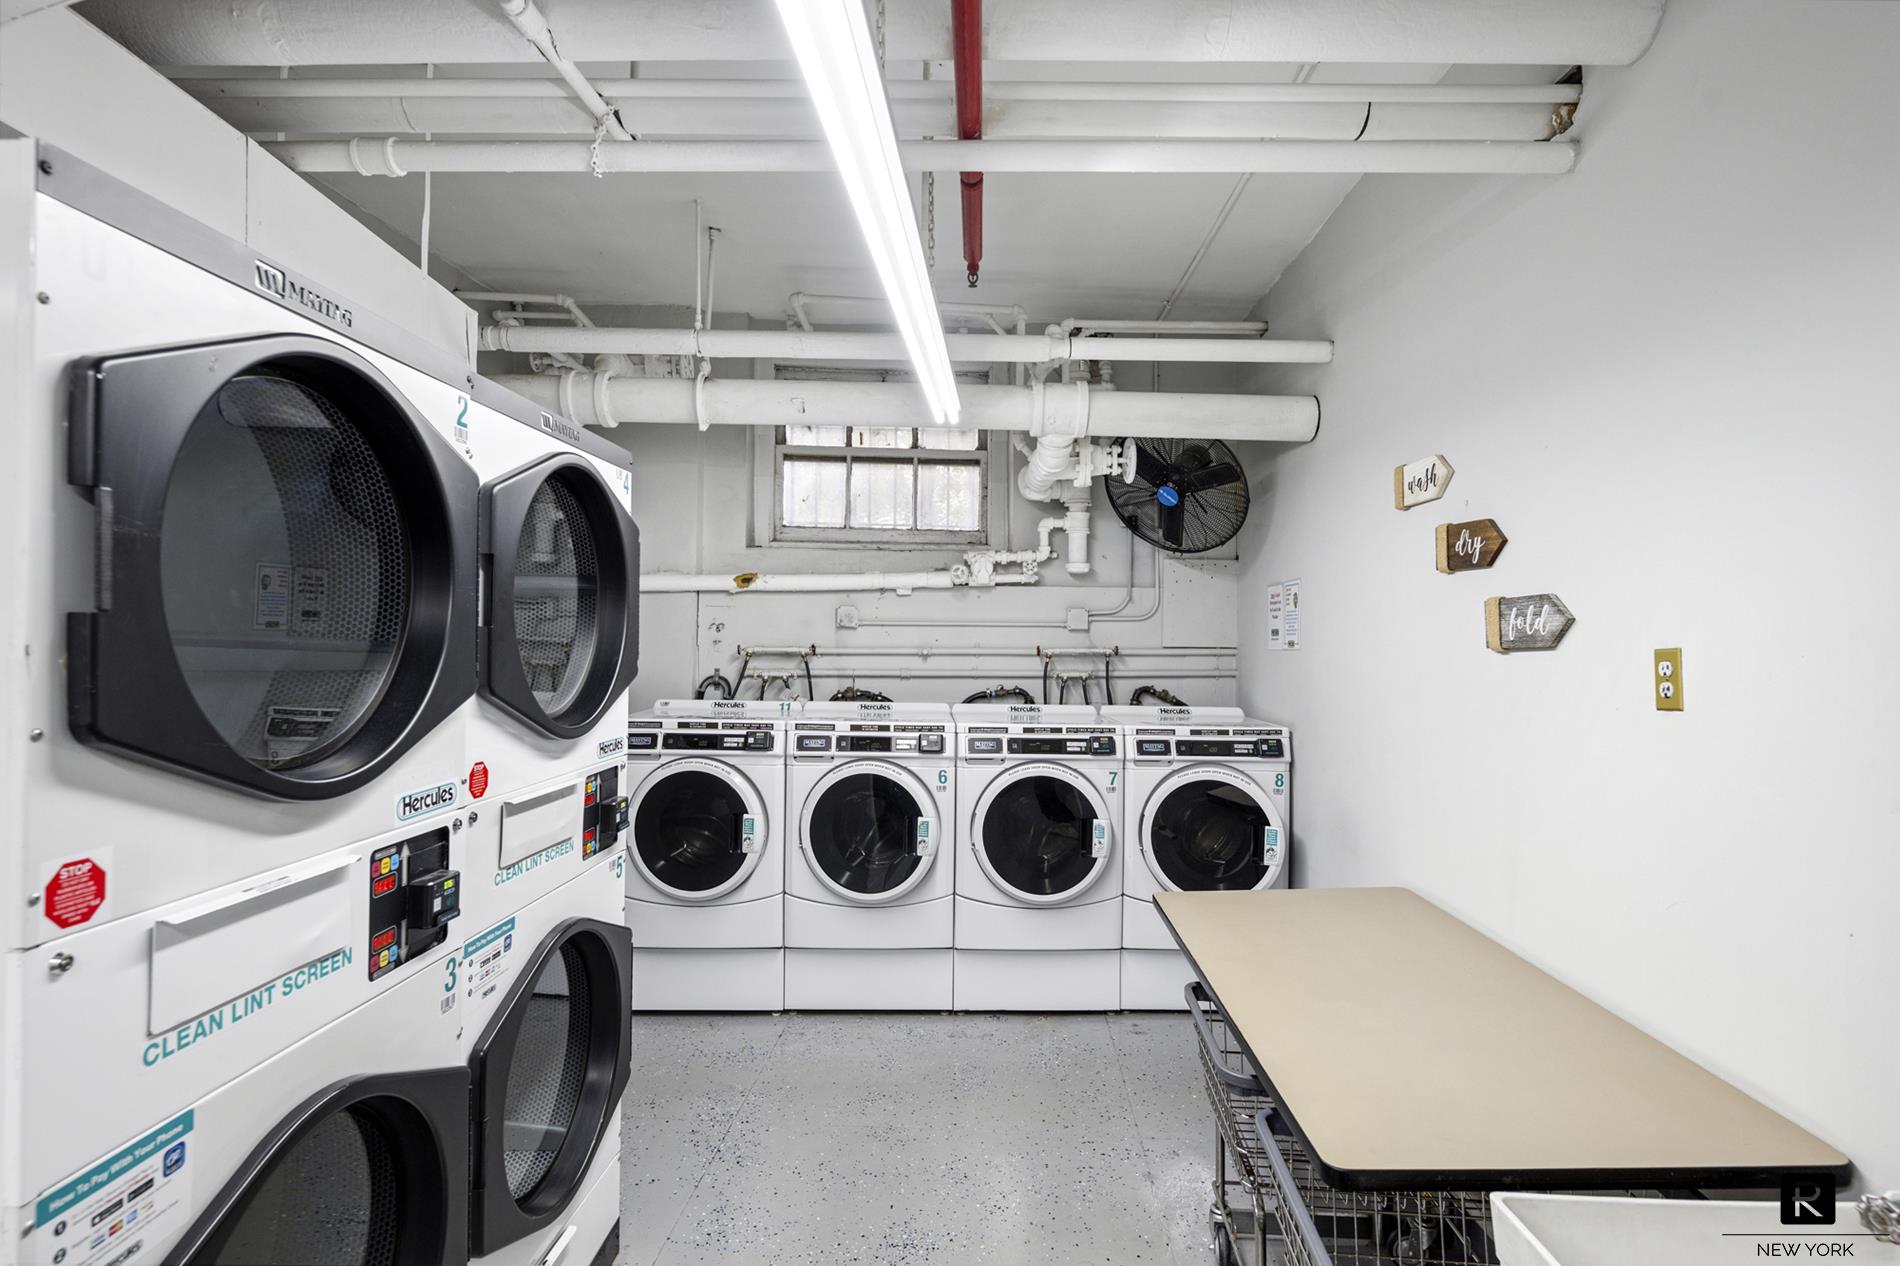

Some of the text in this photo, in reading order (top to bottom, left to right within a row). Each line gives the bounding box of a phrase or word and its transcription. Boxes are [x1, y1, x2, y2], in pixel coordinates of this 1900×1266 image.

[288, 280, 352, 328] MAYTAG
[456, 395, 469, 429] 2
[623, 472, 630, 495] 4
[1407, 463, 1440, 494] wash
[1455, 529, 1486, 564] dry
[1509, 605, 1551, 640] fold
[713, 701, 745, 709] Hercules
[860, 703, 891, 711] Hercules
[1010, 705, 1041, 713] Hercules
[1160, 707, 1190, 715] Hercules
[599, 738, 624, 756] Hercules
[938, 769, 948, 784] 6
[1108, 771, 1118, 785] 7
[1275, 773, 1284, 787] 8
[402, 787, 454, 816] Hercules
[60, 862, 93, 879] STOP
[494, 840, 574, 886] CLEAN LINT SCREEN
[616, 855, 623, 878] 5
[444, 957, 457, 993] 3
[142, 947, 353, 1067] CLEAN LINT SCREEN
